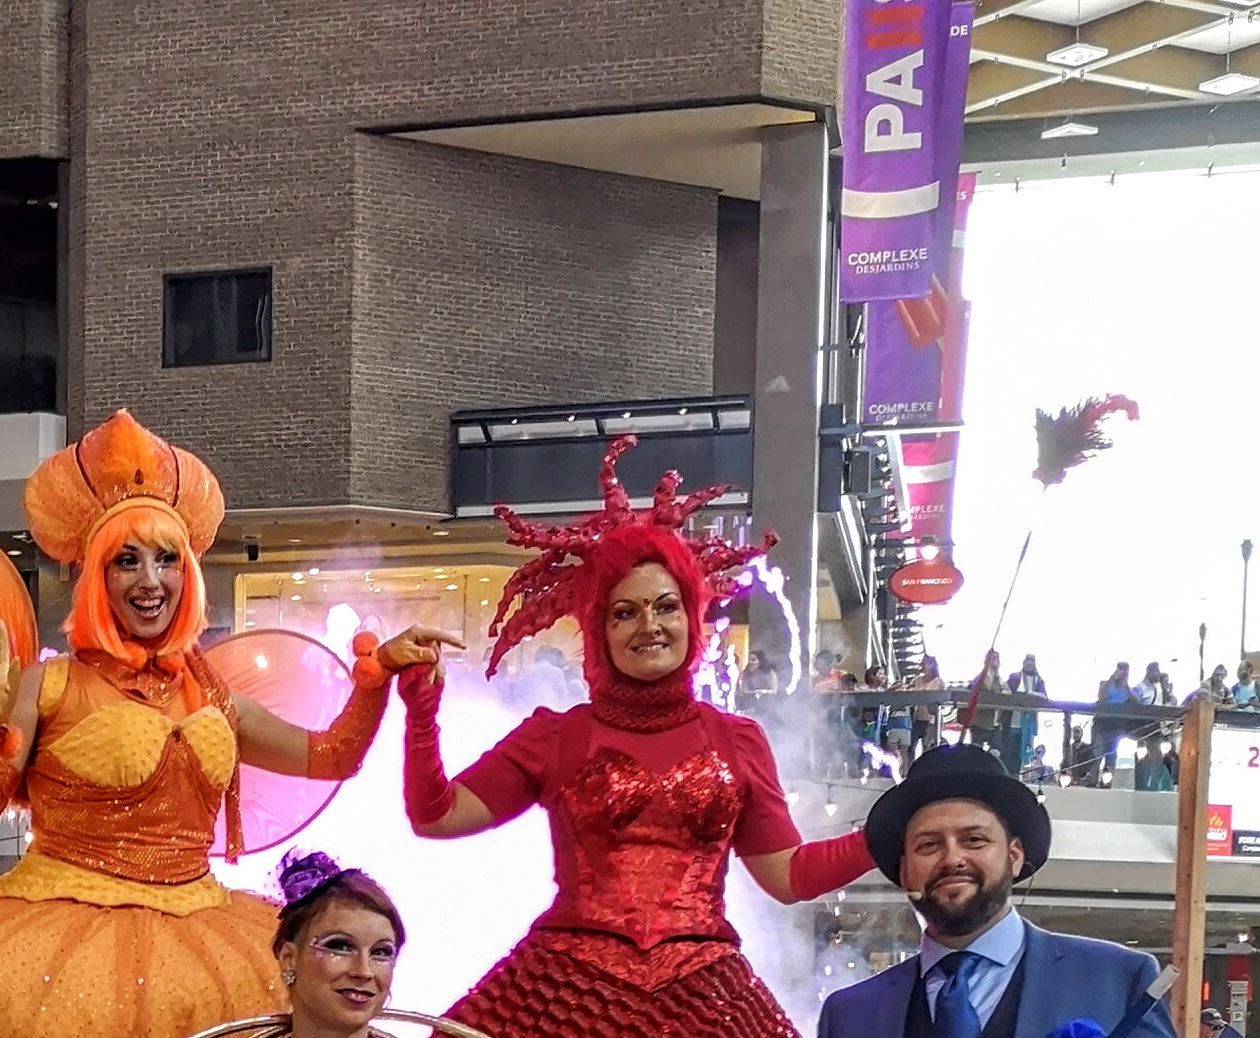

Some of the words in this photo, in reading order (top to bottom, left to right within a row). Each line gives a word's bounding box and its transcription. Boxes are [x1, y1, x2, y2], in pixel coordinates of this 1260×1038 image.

[848, 247, 928, 266] COMPLEXE
[856, 261, 920, 274] DESJARDINS
[869, 401, 934, 415] COMPLEXE
